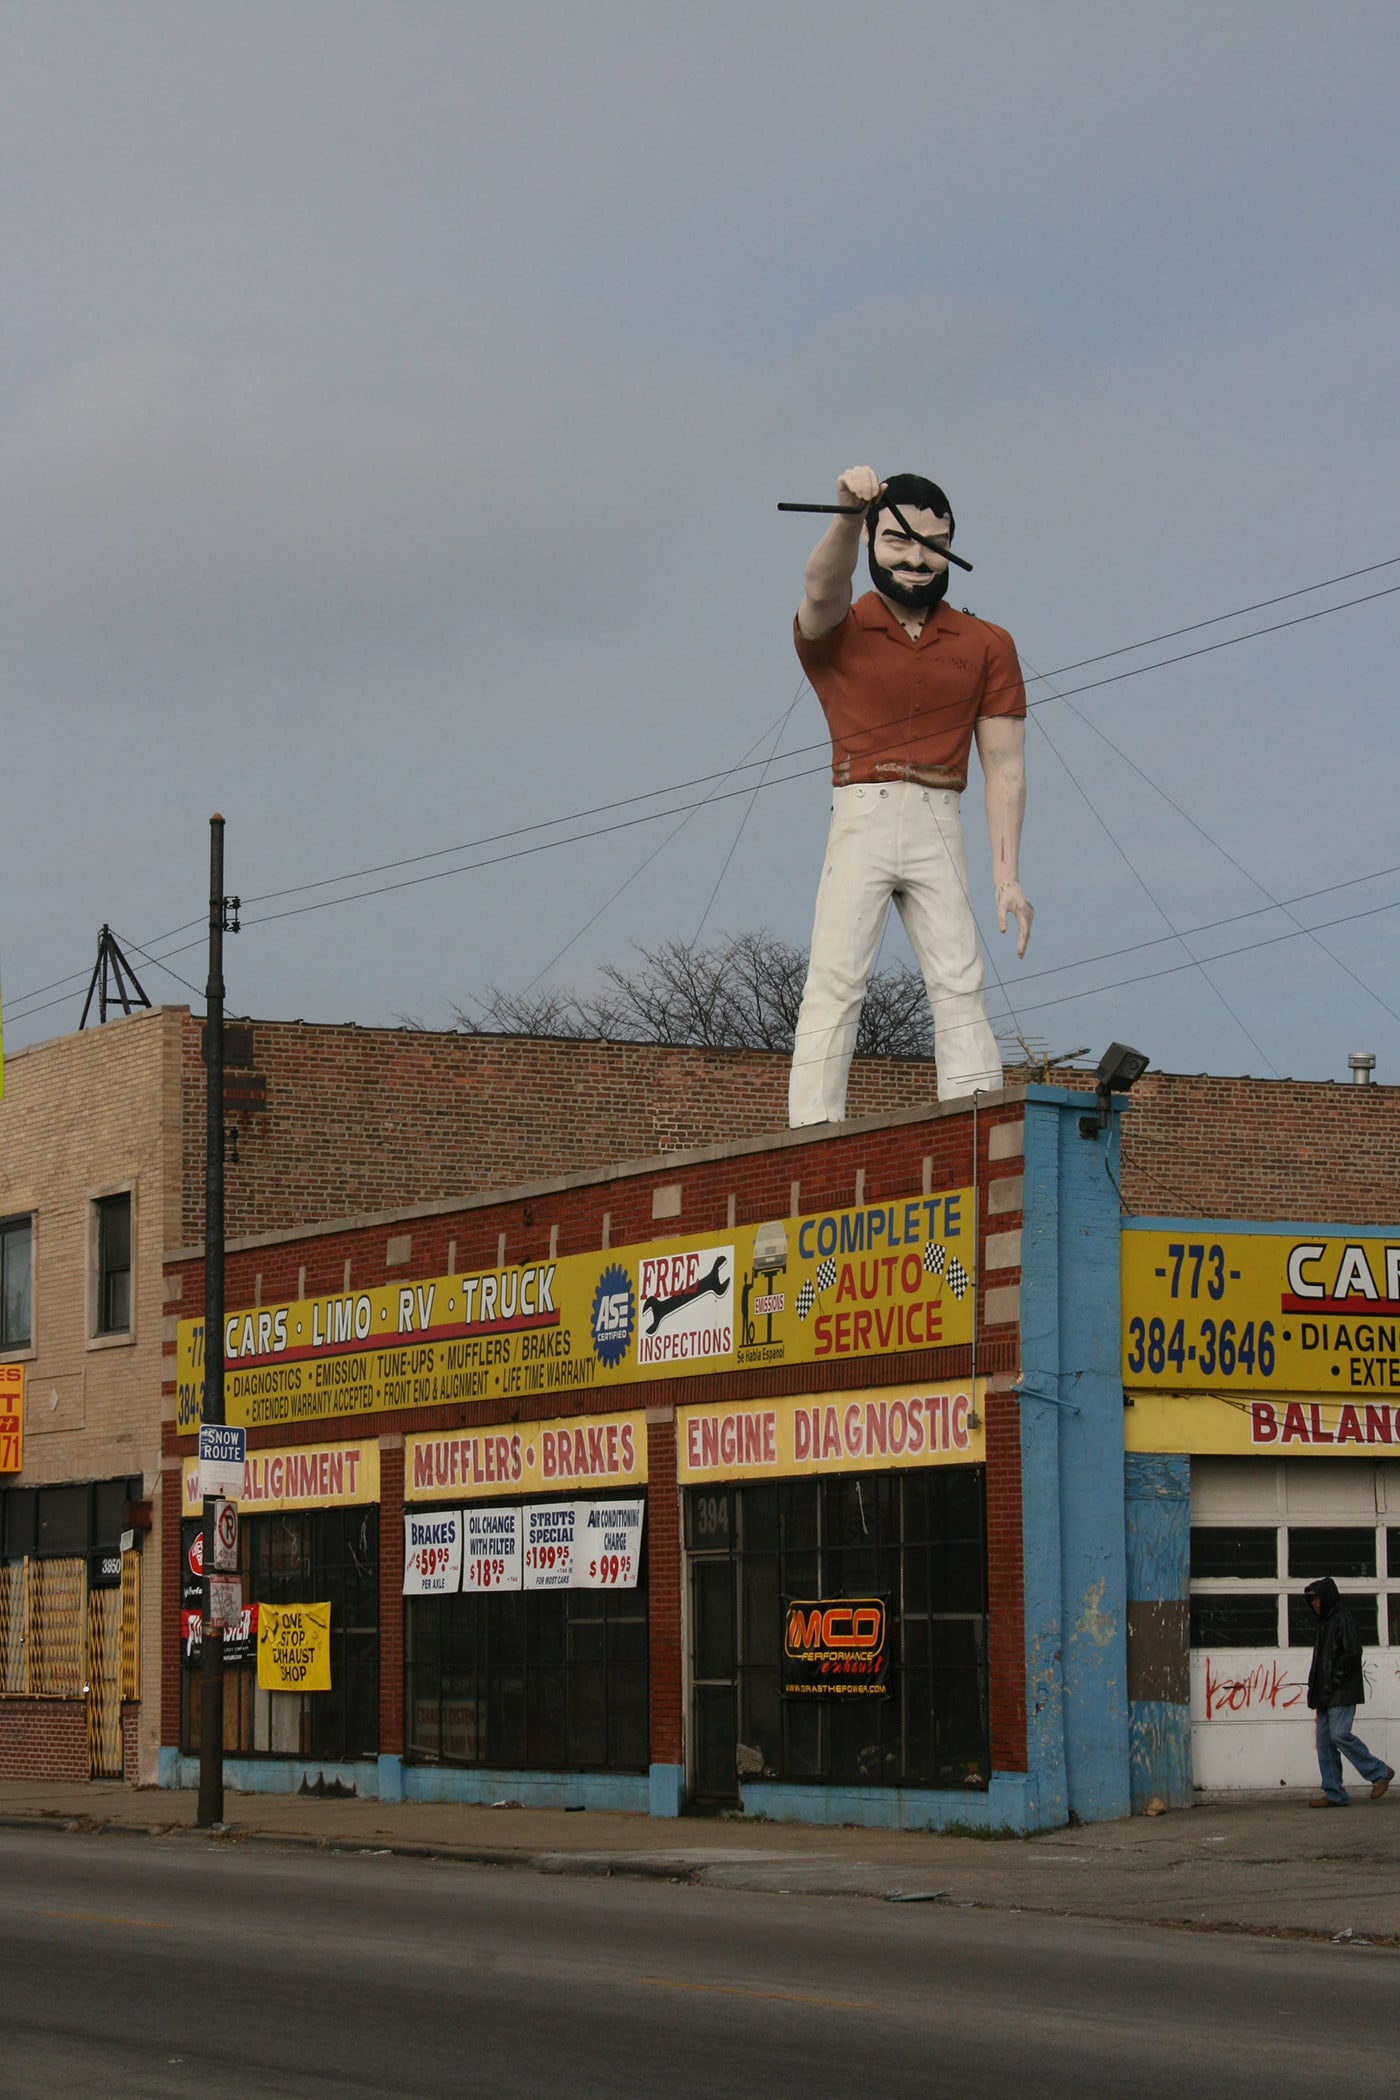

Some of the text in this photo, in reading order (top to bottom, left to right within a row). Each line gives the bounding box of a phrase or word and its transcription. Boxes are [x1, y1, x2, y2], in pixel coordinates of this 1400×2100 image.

[798, 1195, 961, 1260] COMPLETE
[640, 1253, 700, 1300] FREE
[836, 1253, 922, 1303] AUTO
[225, 1264, 556, 1359] CARS LIMO RV TRUCK
[596, 1292, 629, 1332] ASE
[755, 1295, 784, 1314] EMISSIONS
[597, 1329, 627, 1342] CERTIFIED
[814, 1300, 942, 1356] SERVICE
[1301, 1323, 1400, 1352] DIAGN
[640, 1326, 732, 1362] INSPECTIONS
[1128, 1316, 1275, 1377] 384-3646
[233, 1368, 302, 1398] DIAGNOSTICS
[315, 1357, 368, 1388] EMISSION
[377, 1348, 434, 1379] TUNE-UPS
[448, 1335, 510, 1370] MUFFLERS
[521, 1330, 572, 1362] BRAKES
[252, 1395, 289, 1422] EXTENDED
[291, 1390, 333, 1417] WARRANTY
[334, 1384, 374, 1412] ACCEPTED
[383, 1379, 412, 1406] FRONT
[413, 1376, 431, 1403] END
[440, 1370, 490, 1398] ALIGNMENT
[503, 1366, 522, 1393] LIFE
[524, 1361, 545, 1390] TIME
[547, 1356, 597, 1386] WARRANTY
[687, 1394, 969, 1468] ENGINE DIAGNOSTIC
[1250, 1402, 1400, 1443] BALAN
[207, 1430, 239, 1446] SNOW
[204, 1444, 241, 1461] ROUTE
[413, 1423, 634, 1489] MUFFLERS BRAKES
[242, 1449, 360, 1500] ALIGNMENT
[469, 1515, 515, 1534] OIL CHANGE
[530, 1510, 576, 1528] STRUTS
[411, 1520, 456, 1546] BRAKES
[470, 1537, 516, 1556] WITH FILTER
[604, 1533, 627, 1551] CHARGE
[421, 1578, 446, 1590] PER AXLE
[282, 1613, 303, 1629] ONE
[281, 1630, 305, 1646] STOP
[273, 1647, 315, 1664] EXHAUST
[802, 1651, 873, 1662] PERFORMANCE
[281, 1666, 306, 1682] SHOP
